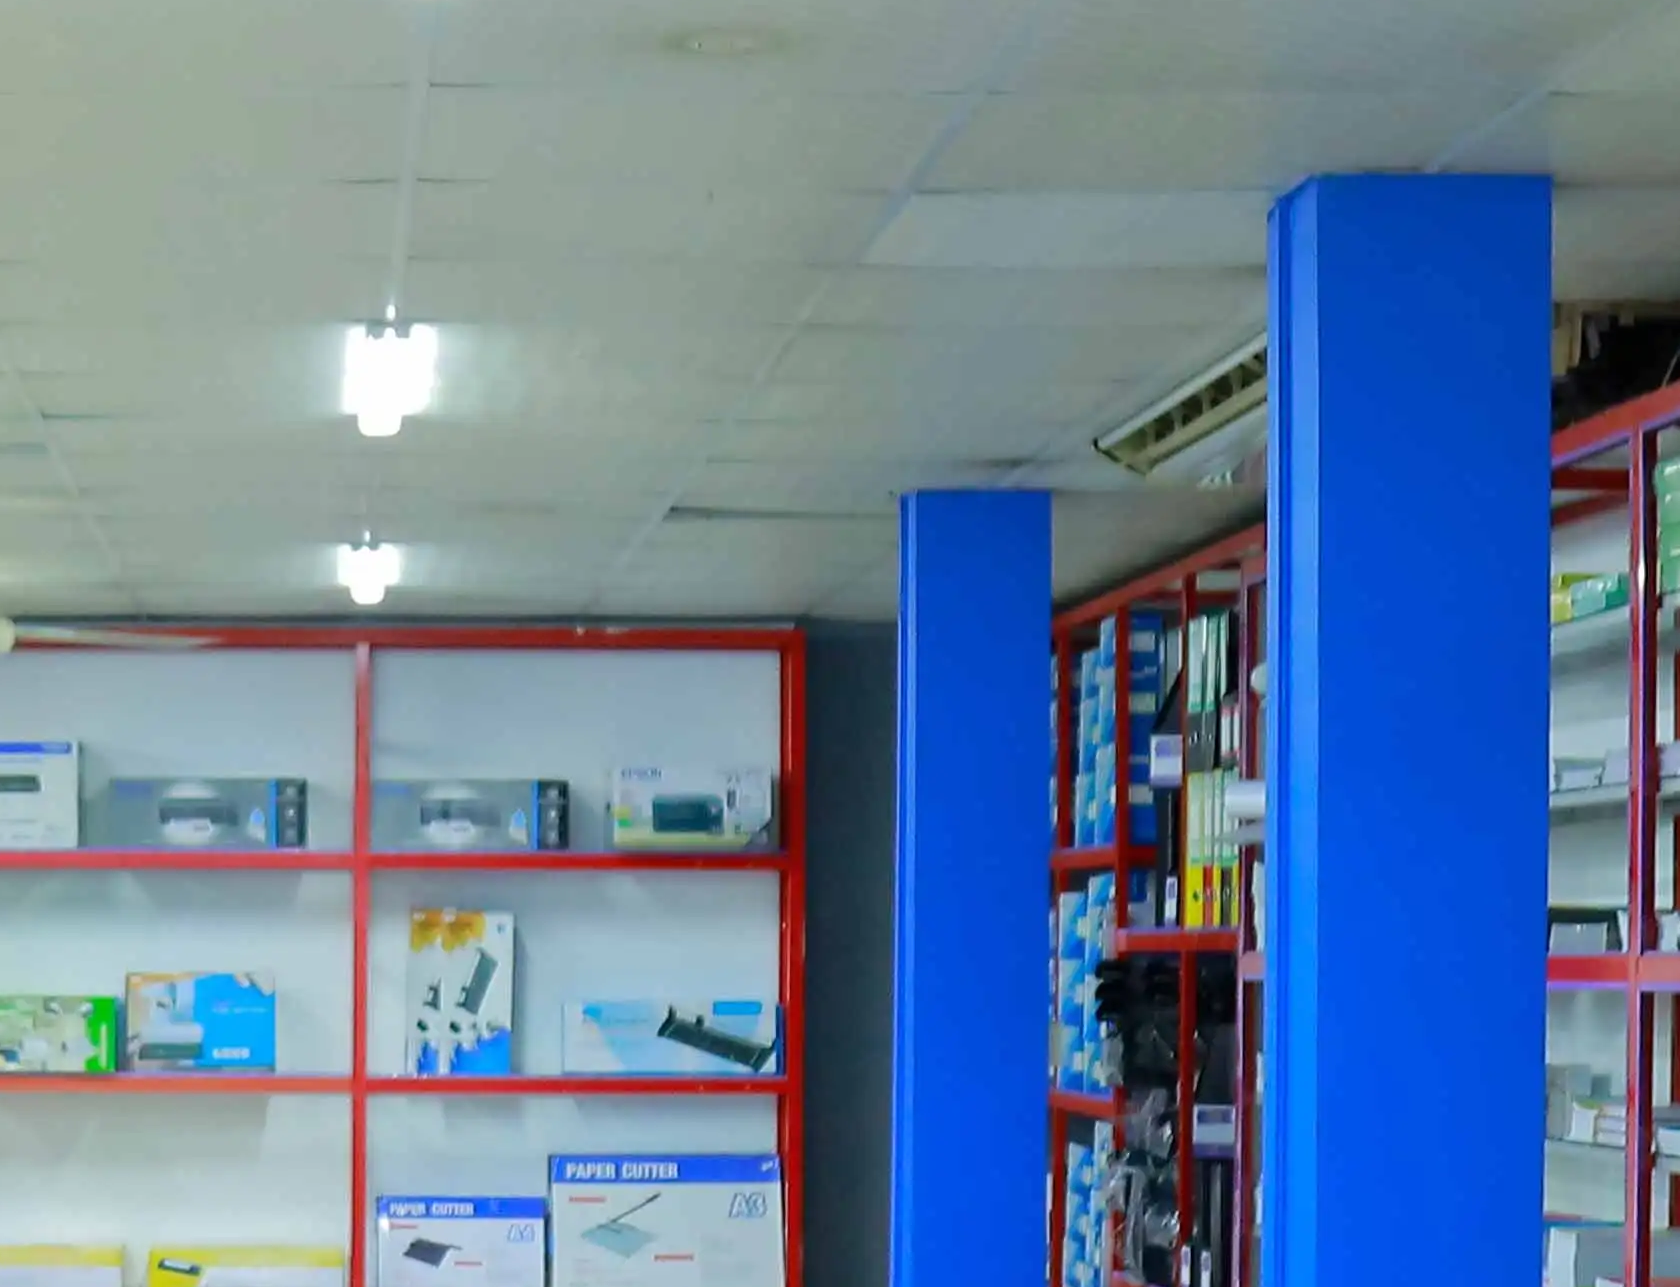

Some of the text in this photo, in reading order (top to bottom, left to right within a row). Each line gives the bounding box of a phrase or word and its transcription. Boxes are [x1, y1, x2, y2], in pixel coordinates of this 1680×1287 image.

[566, 1162, 679, 1181] PAPER CUTTER
[389, 1201, 475, 1217] PAPER CUTTER
